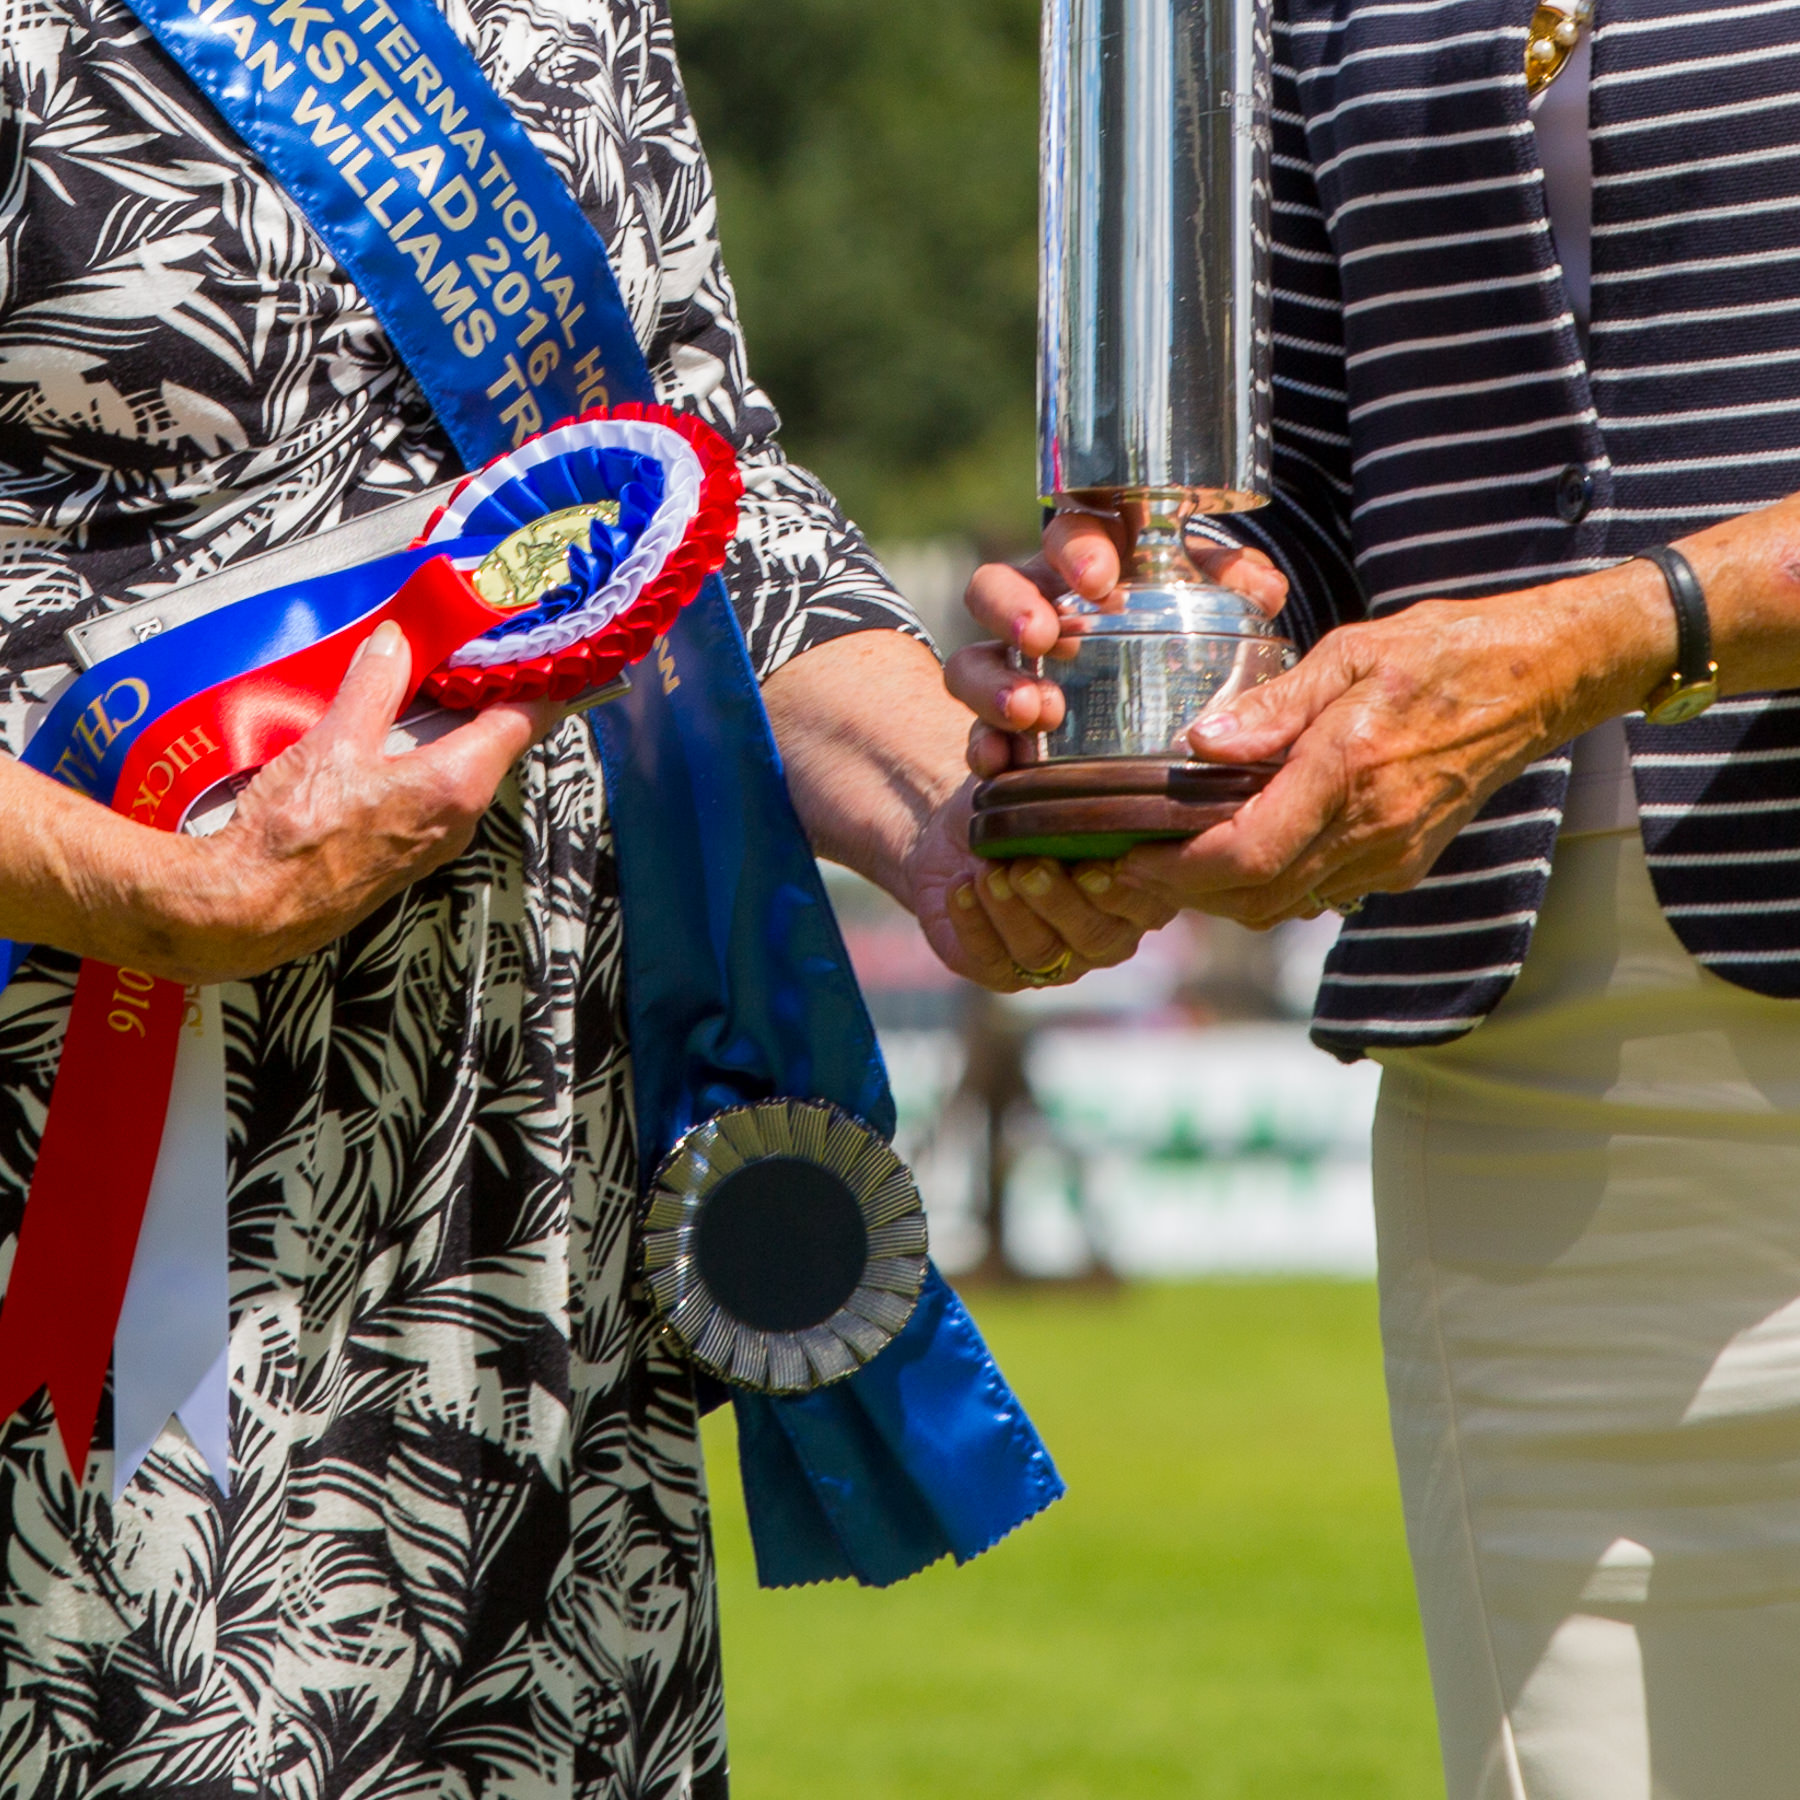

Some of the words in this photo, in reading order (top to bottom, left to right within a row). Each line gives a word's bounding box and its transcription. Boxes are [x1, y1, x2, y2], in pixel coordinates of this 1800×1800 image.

[292, 85, 497, 359] WILLIAMS
[485, 352, 543, 450] TR
[467, 236, 561, 388] 2016
[573, 345, 610, 416] HO
[128, 725, 220, 825] HICK
[107, 966, 155, 1039] 016
